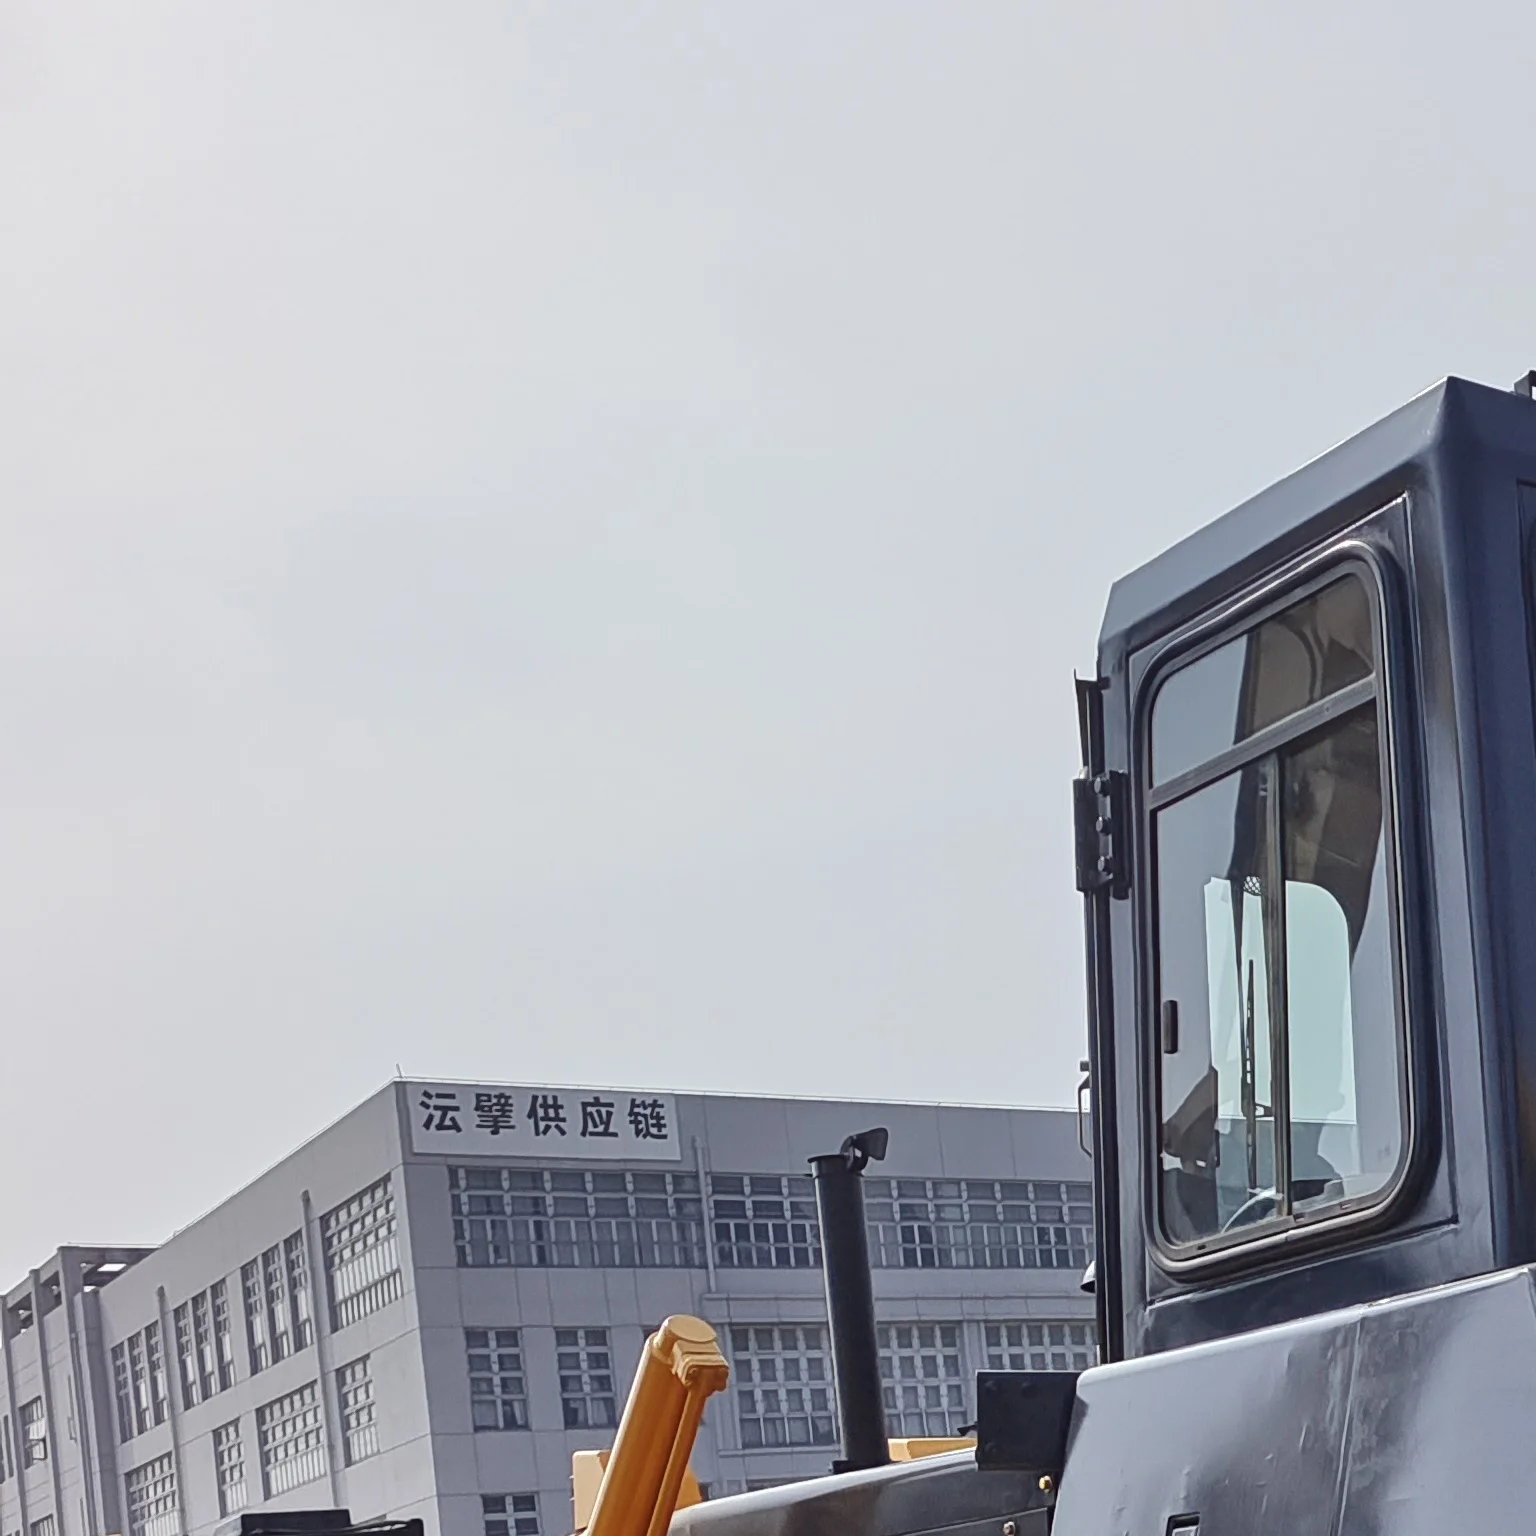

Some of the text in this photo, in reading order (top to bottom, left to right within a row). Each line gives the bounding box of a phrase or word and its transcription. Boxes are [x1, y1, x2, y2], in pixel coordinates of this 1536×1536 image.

[419, 1090, 669, 1140] 沄擘供应链
